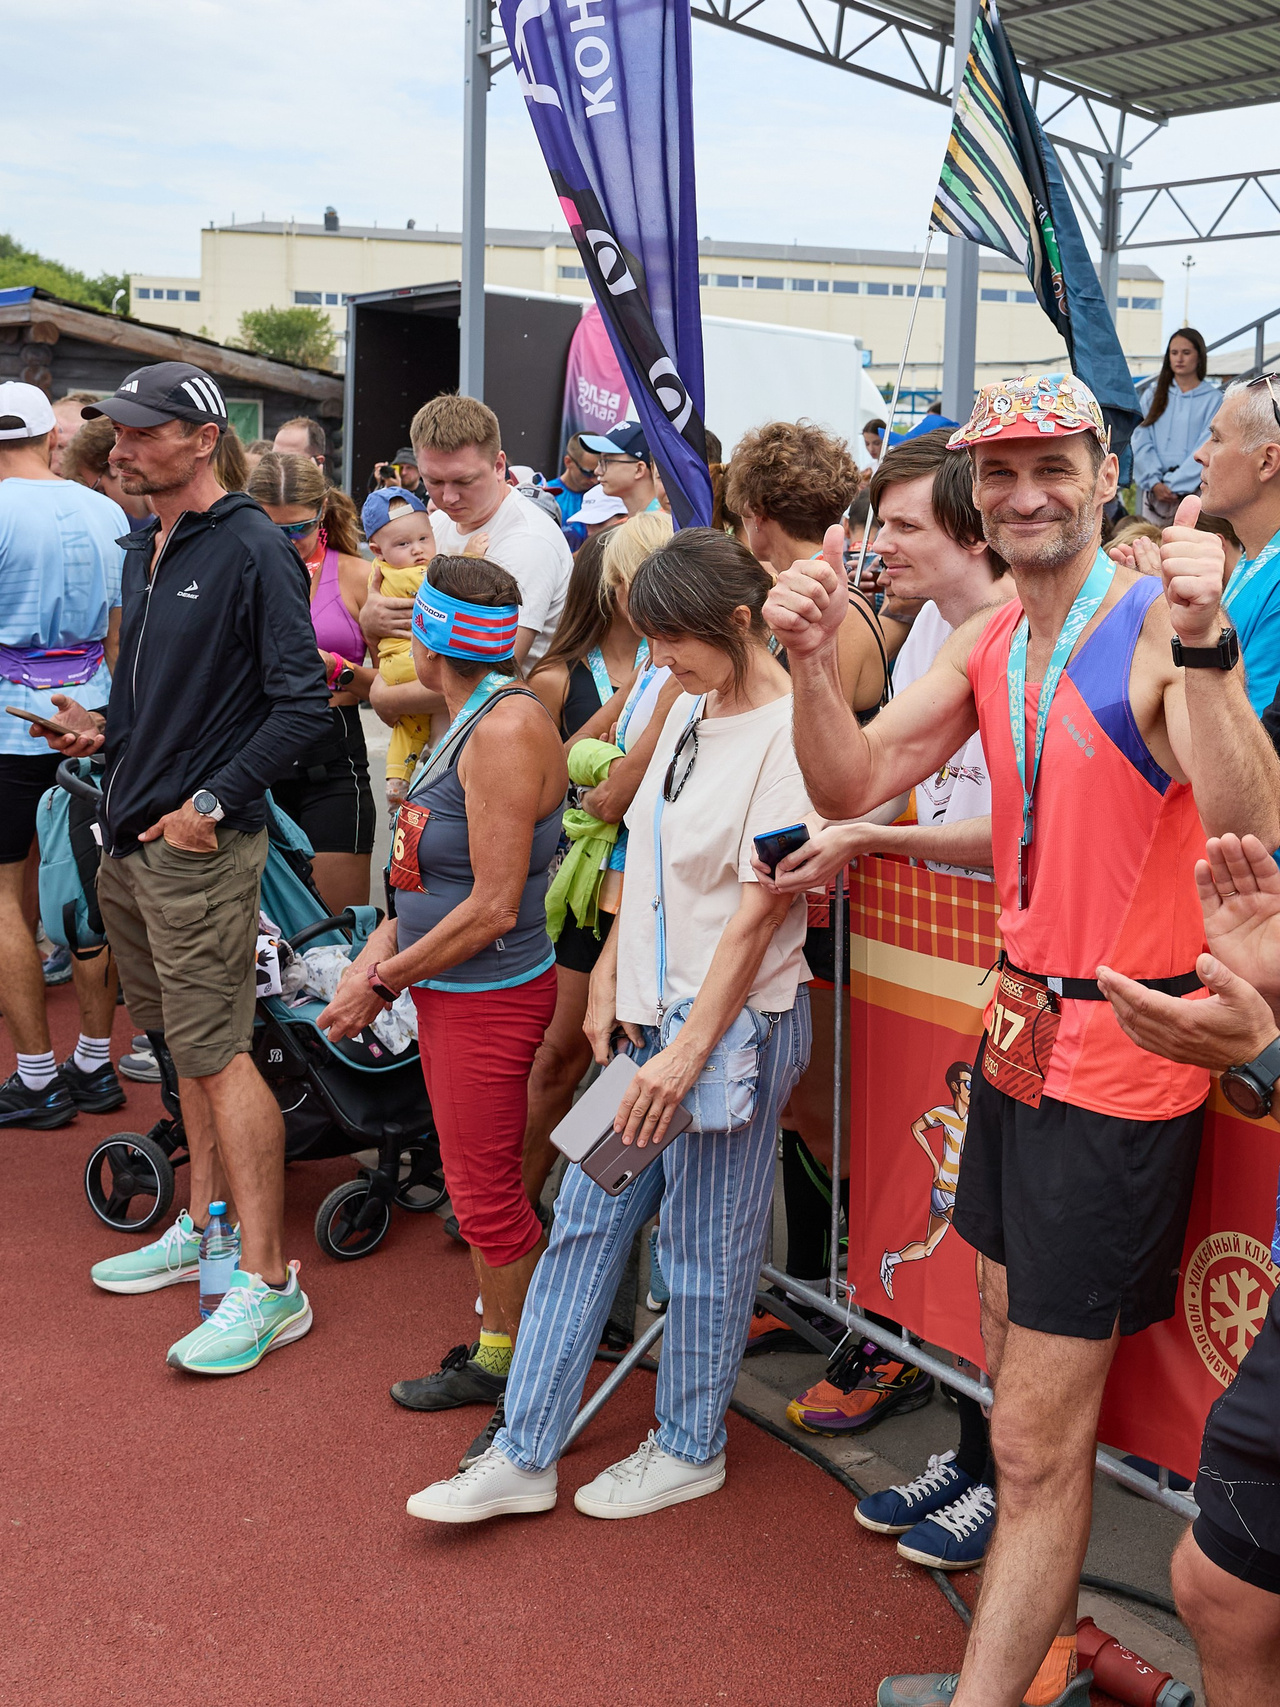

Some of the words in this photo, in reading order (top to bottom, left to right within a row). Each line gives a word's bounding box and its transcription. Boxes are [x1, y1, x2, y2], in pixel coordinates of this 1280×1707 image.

[1009, 669, 1019, 717] КРОСС
[1039, 665, 1058, 712] КРОСС
[1188, 1233, 1241, 1290] ХОККЕЙНЫЙ
[1188, 1303, 1235, 1385] НОВОСИБИР
